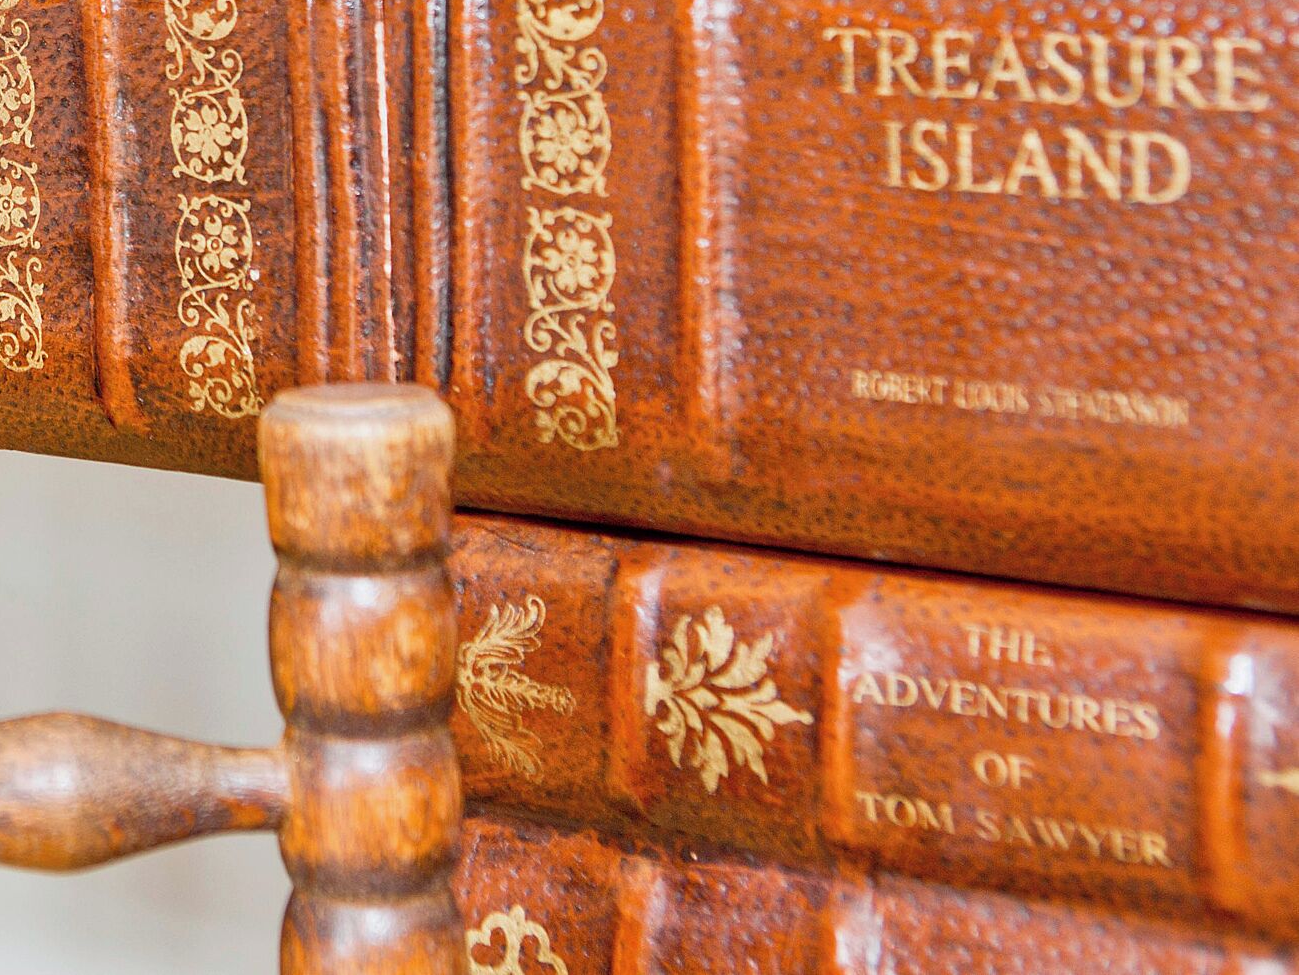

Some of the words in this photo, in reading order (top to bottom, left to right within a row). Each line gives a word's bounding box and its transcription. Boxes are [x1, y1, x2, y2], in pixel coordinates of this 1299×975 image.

[822, 27, 1271, 112] TREASURE
[883, 119, 1192, 204] ISLAND
[851, 369, 949, 405] ROBERT
[962, 623, 1054, 668] THE
[853, 672, 1161, 740] ADVENTURES
[972, 749, 1036, 791] OF
[854, 791, 955, 836] TOM
[975, 809, 1172, 867] SAWYER
